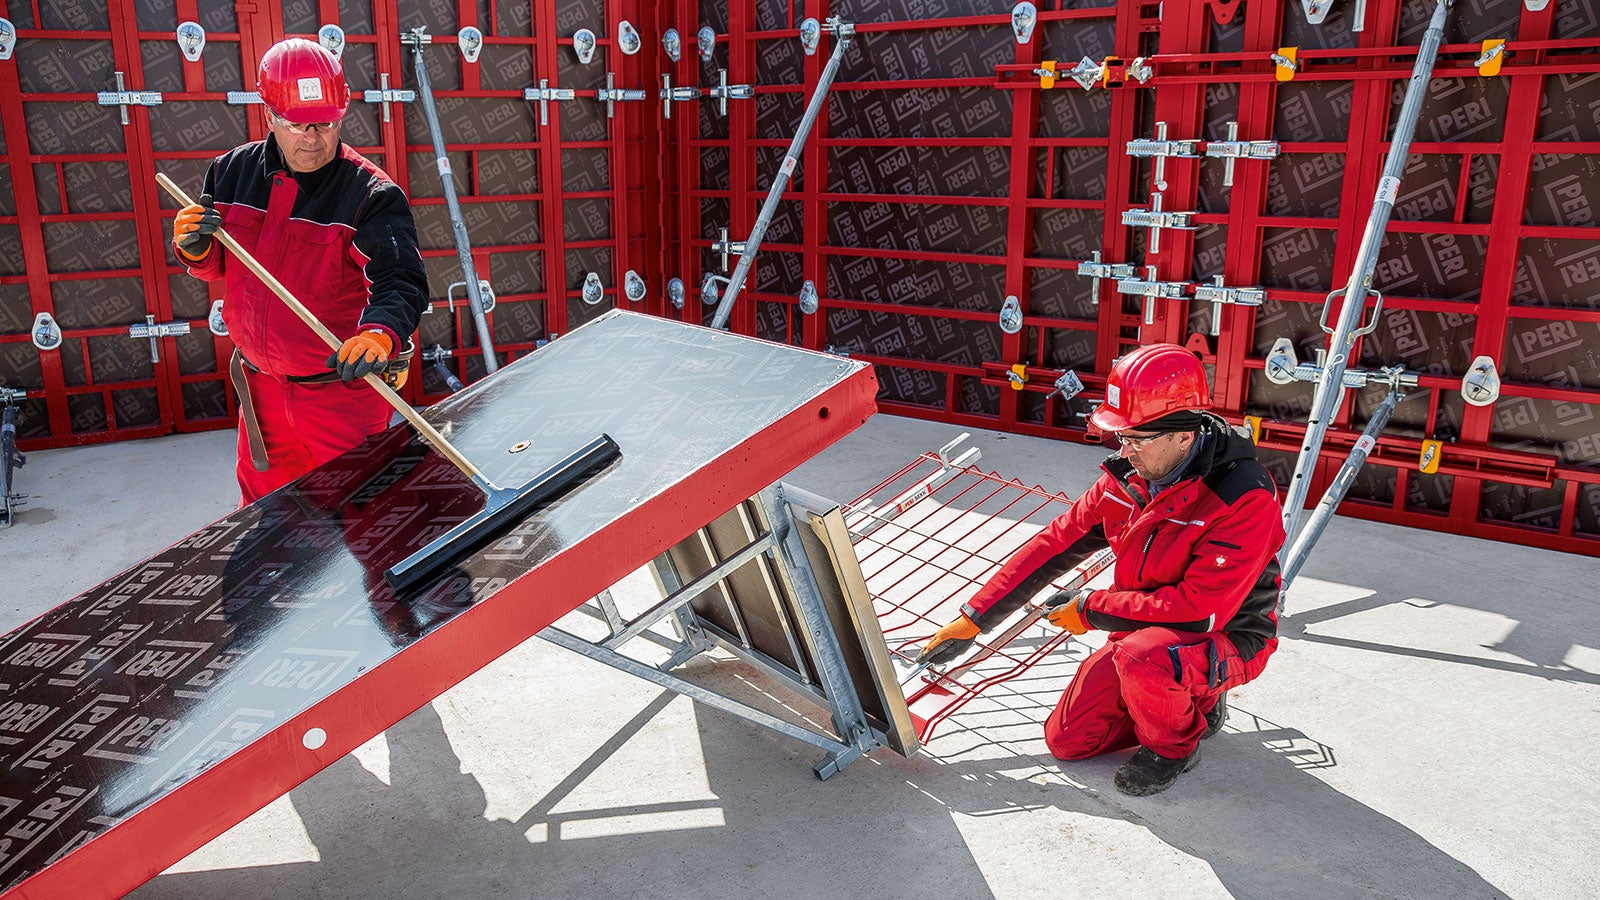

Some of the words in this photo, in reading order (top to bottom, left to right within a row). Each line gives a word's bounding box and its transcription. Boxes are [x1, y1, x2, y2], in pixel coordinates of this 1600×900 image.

[758, 2, 777, 30] PERI
[501, 56, 531, 82] PERI
[765, 42, 791, 69] PERI
[486, 101, 517, 127] PERI
[965, 97, 997, 125] PERI
[1053, 95, 1076, 134] PERI
[1280, 96, 1308, 141] PERI
[1437, 97, 1492, 136] PERI
[183, 116, 219, 144] PERI
[575, 120, 605, 141] PERI
[878, 152, 908, 178] PERI
[946, 163, 976, 192] PERI
[584, 201, 608, 236] PERI
[766, 220, 793, 243] PERI
[929, 212, 959, 239] PERI
[1046, 209, 1080, 235] PERI
[1266, 233, 1311, 266] PERI
[1433, 235, 1469, 280] PERI
[847, 261, 876, 285] PERI
[513, 303, 535, 333] PERI
[833, 307, 859, 328] PERI
[1521, 320, 1577, 353] PERI
[1059, 341, 1092, 361] PERI
[88, 570, 164, 616] PERI
[60, 623, 144, 676] PERI
[249, 659, 336, 690] PERI
[22, 705, 119, 770] PERI
